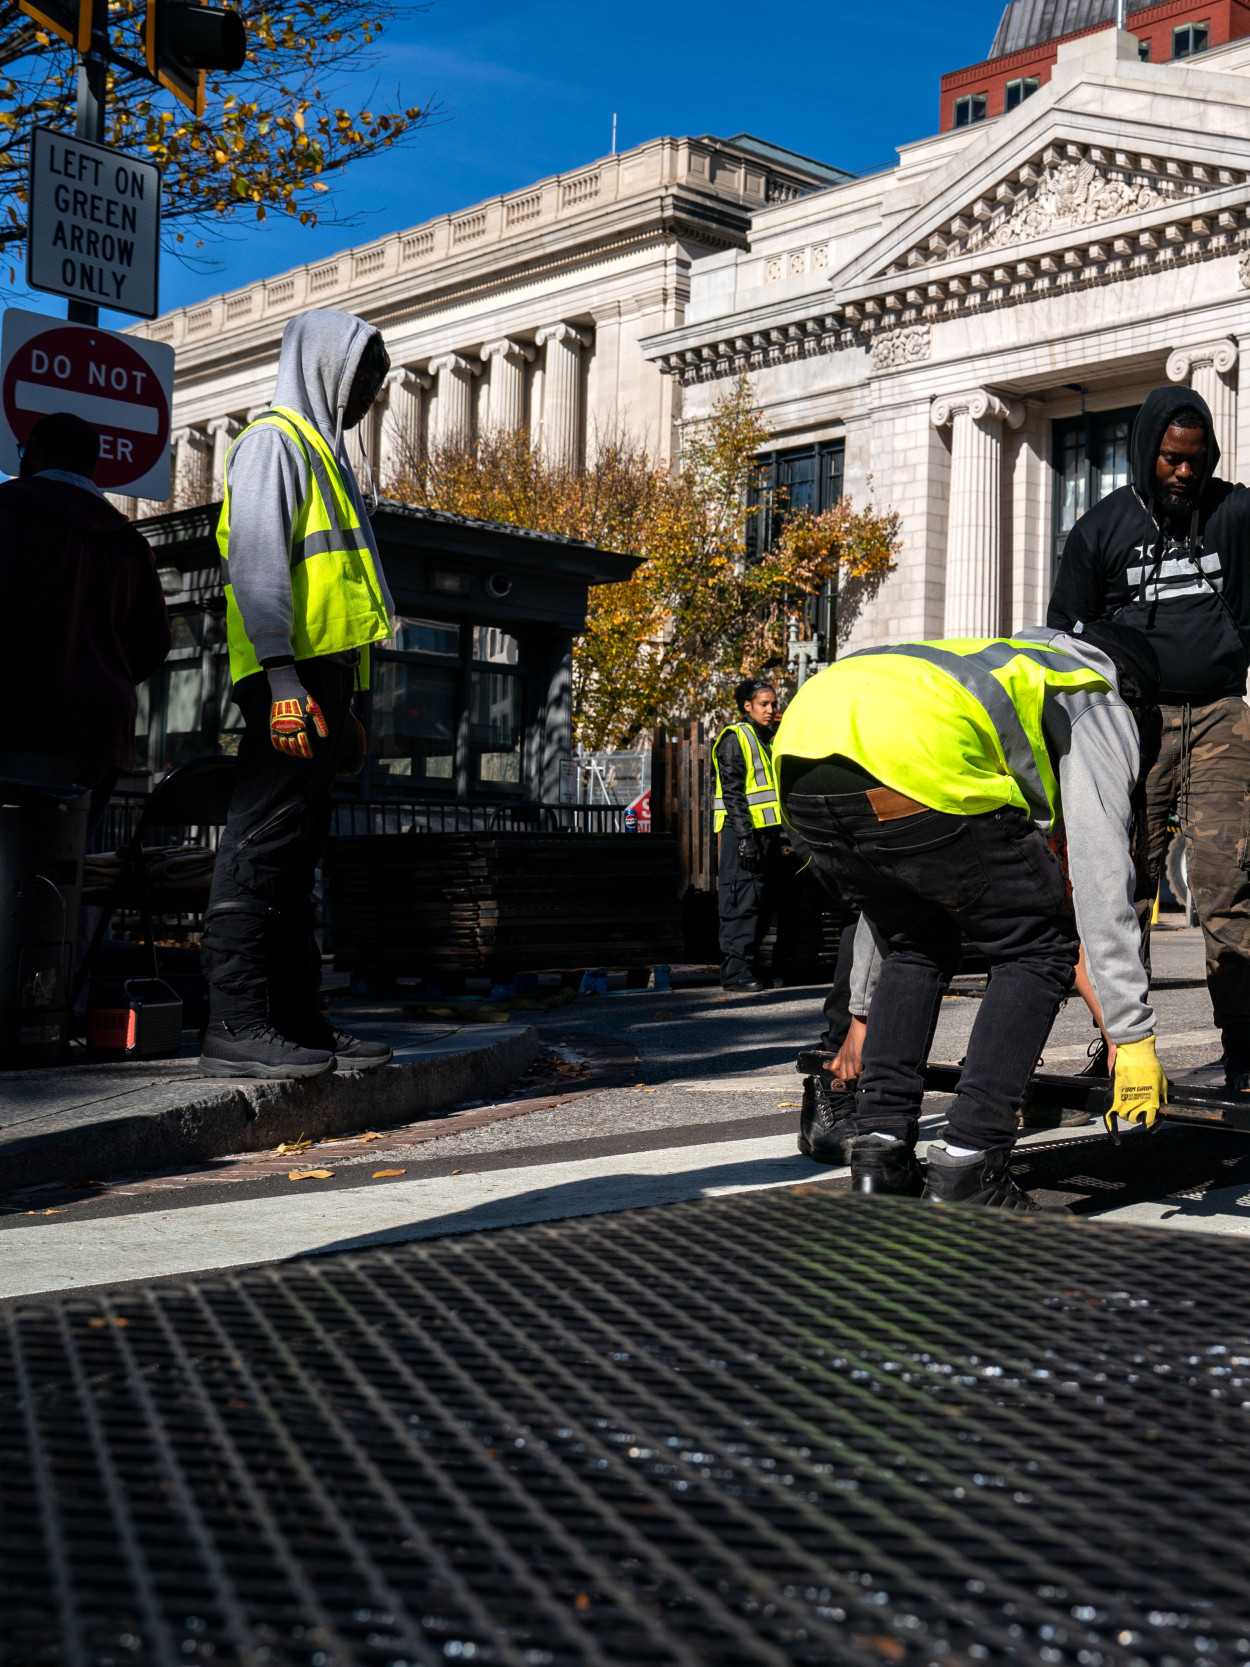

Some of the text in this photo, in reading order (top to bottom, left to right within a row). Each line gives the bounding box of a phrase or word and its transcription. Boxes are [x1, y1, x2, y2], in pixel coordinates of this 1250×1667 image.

[50, 144, 144, 200] LEFT ON
[54, 184, 137, 234] GREEN
[52, 220, 134, 267] ARROW
[62, 258, 126, 300] ONLY
[31, 349, 147, 395] DO NOT
